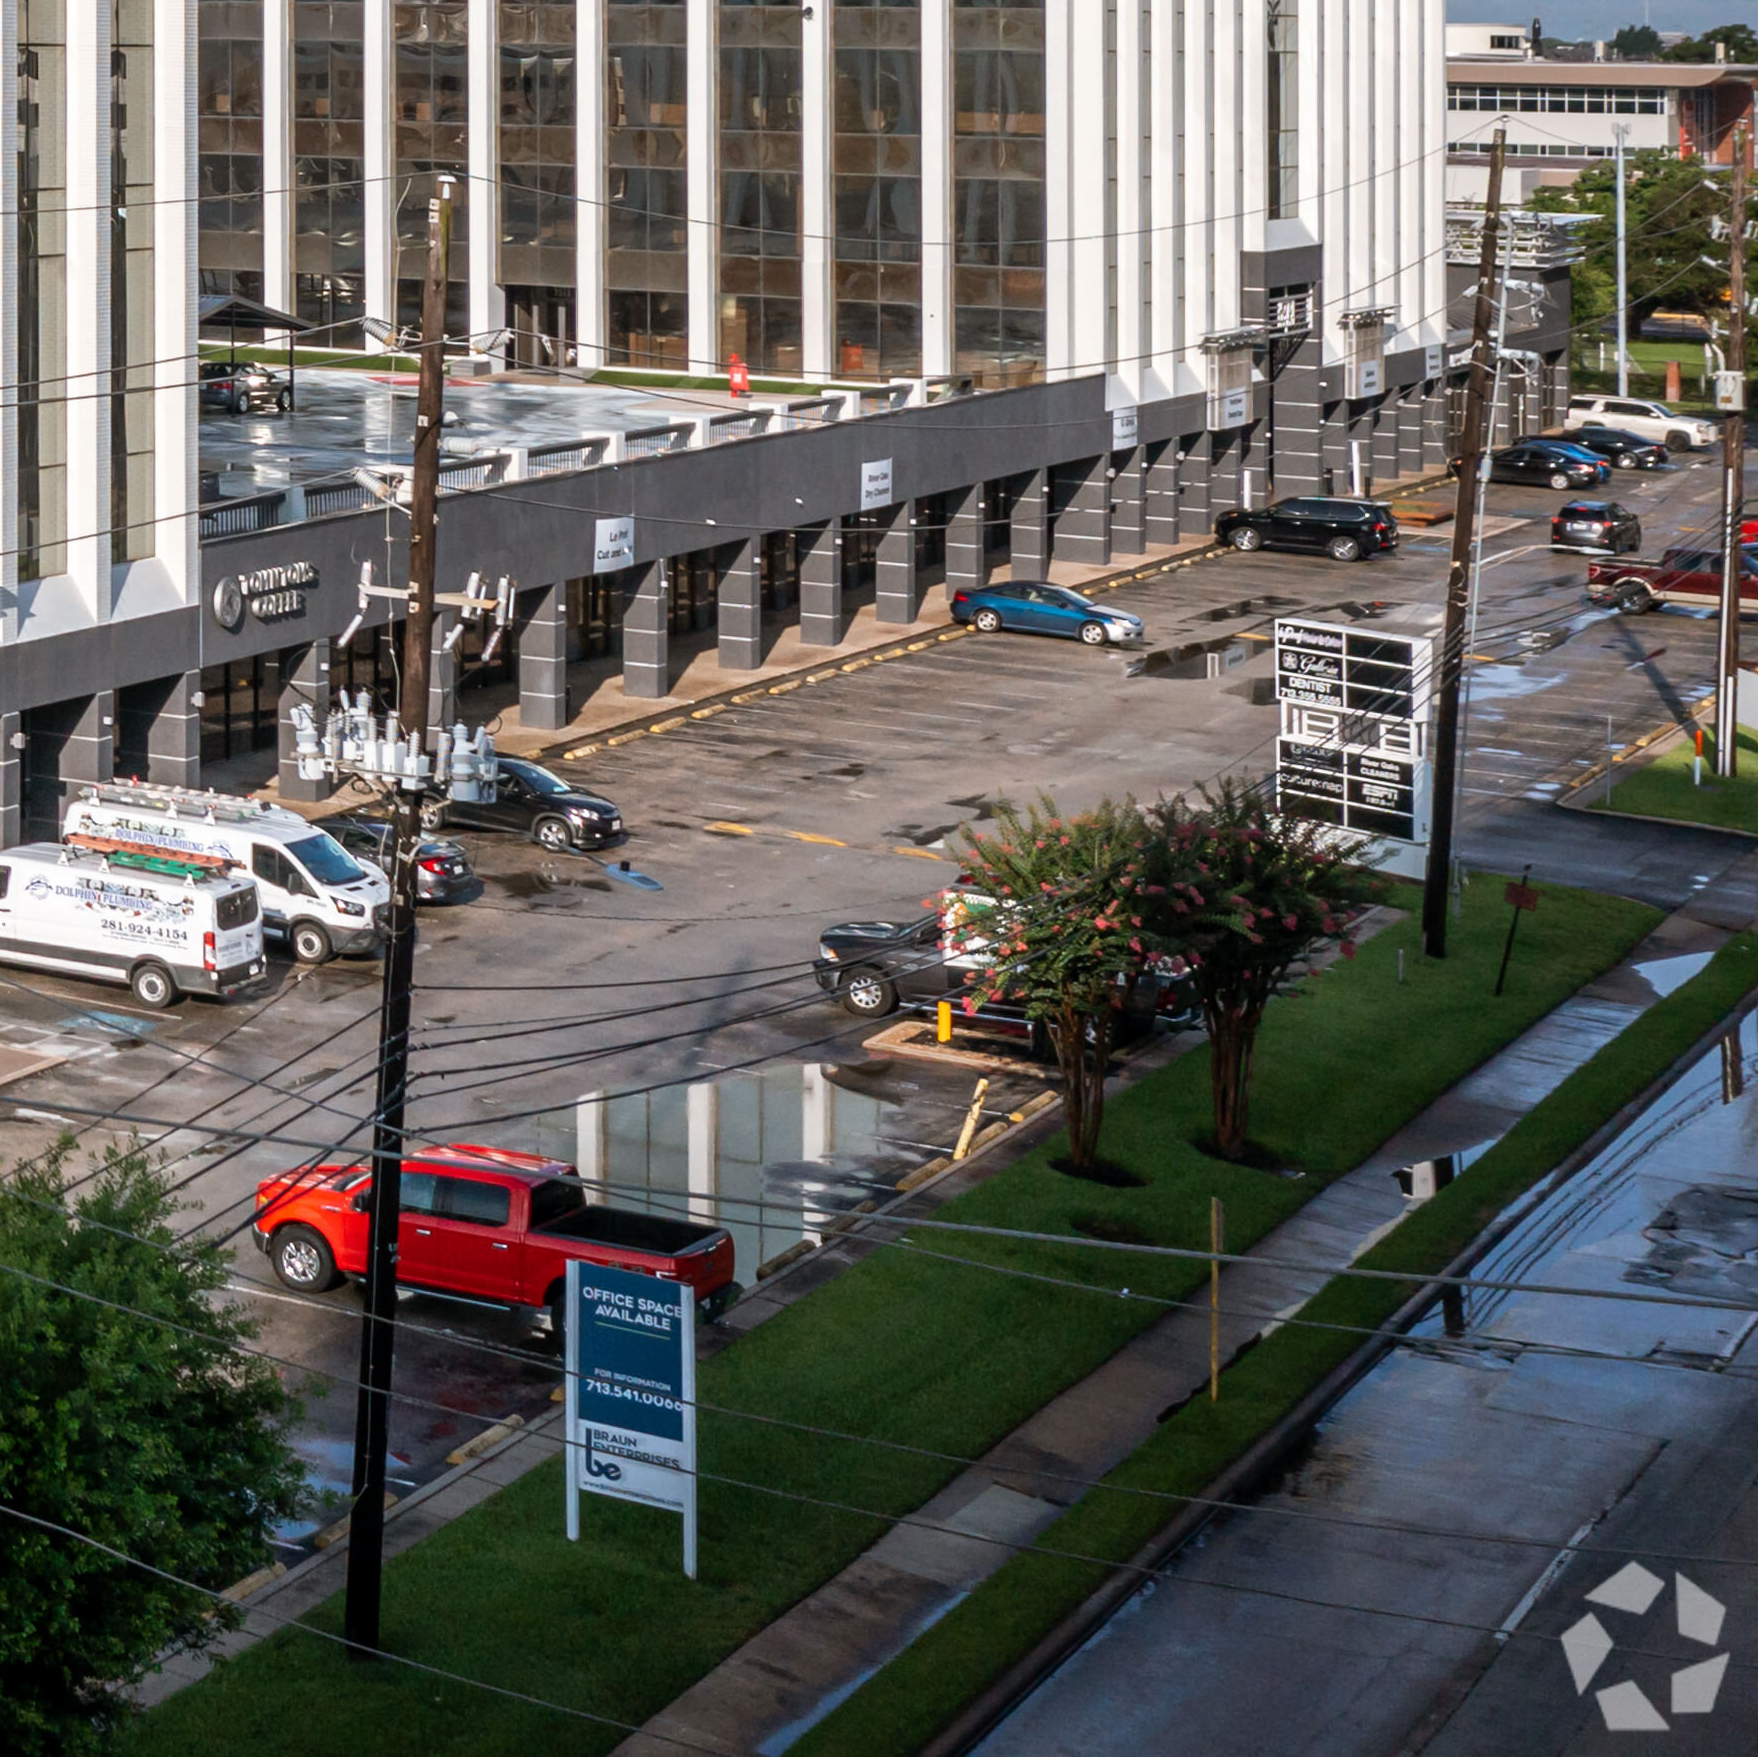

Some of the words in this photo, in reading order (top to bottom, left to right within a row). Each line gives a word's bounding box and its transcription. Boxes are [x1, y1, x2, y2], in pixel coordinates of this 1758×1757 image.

[1289, 676, 1332, 694] DENTIST
[114, 827, 155, 845] DOLPHIN
[158, 833, 205, 853] PLUMBING
[55, 885, 98, 901] DOLPHIN
[103, 892, 153, 911] PLUMBING
[101, 918, 188, 941] 281-924-4154
[583, 1286, 634, 1308] OFFICE
[637, 1298, 684, 1318] SPACE
[595, 1304, 672, 1331] AVAILABLE
[594, 1367, 612, 1380] FOR
[613, 1372, 672, 1392] INFORMATION
[586, 1379, 684, 1412] 713.541.0066
[593, 1429, 638, 1448] BRAUN
